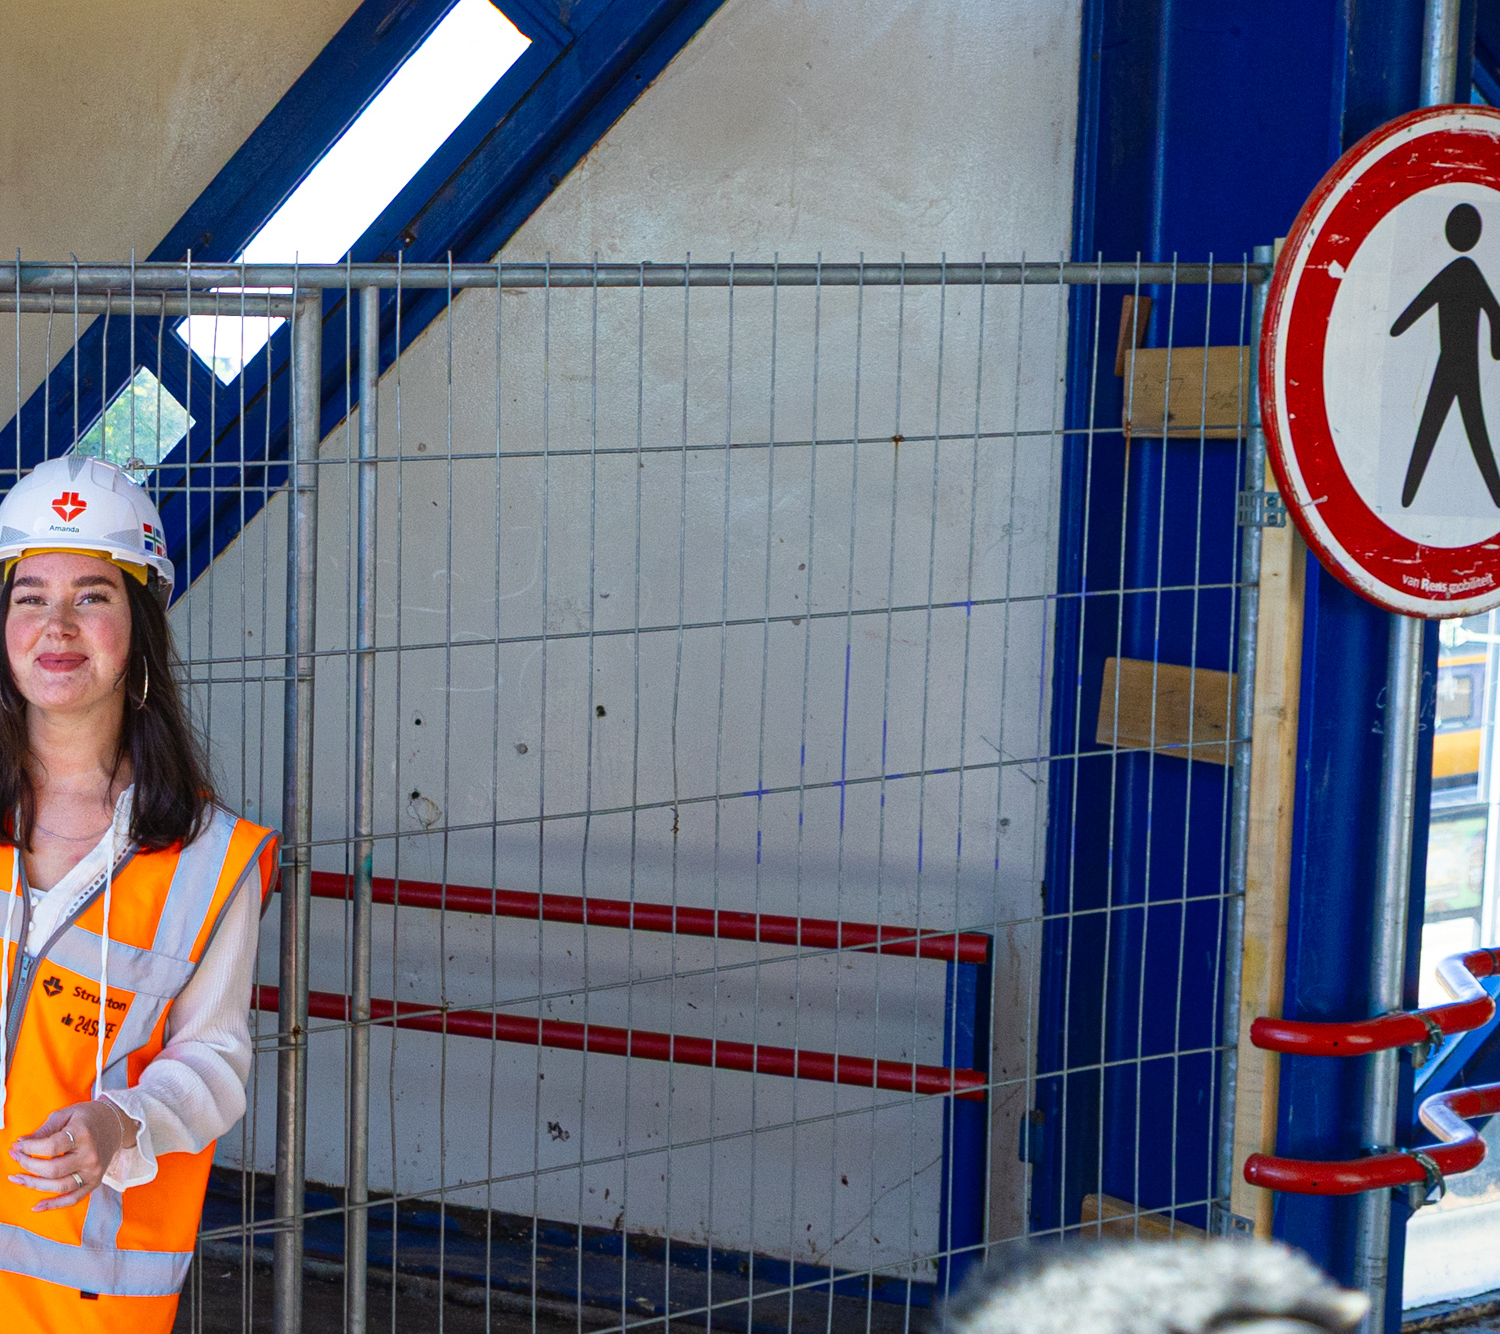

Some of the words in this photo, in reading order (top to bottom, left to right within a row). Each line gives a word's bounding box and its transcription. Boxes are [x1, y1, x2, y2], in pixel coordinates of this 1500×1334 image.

[49, 525, 80, 533] Amanda
[1402, 574, 1420, 589] van
[73, 986, 127, 1012] Struton
